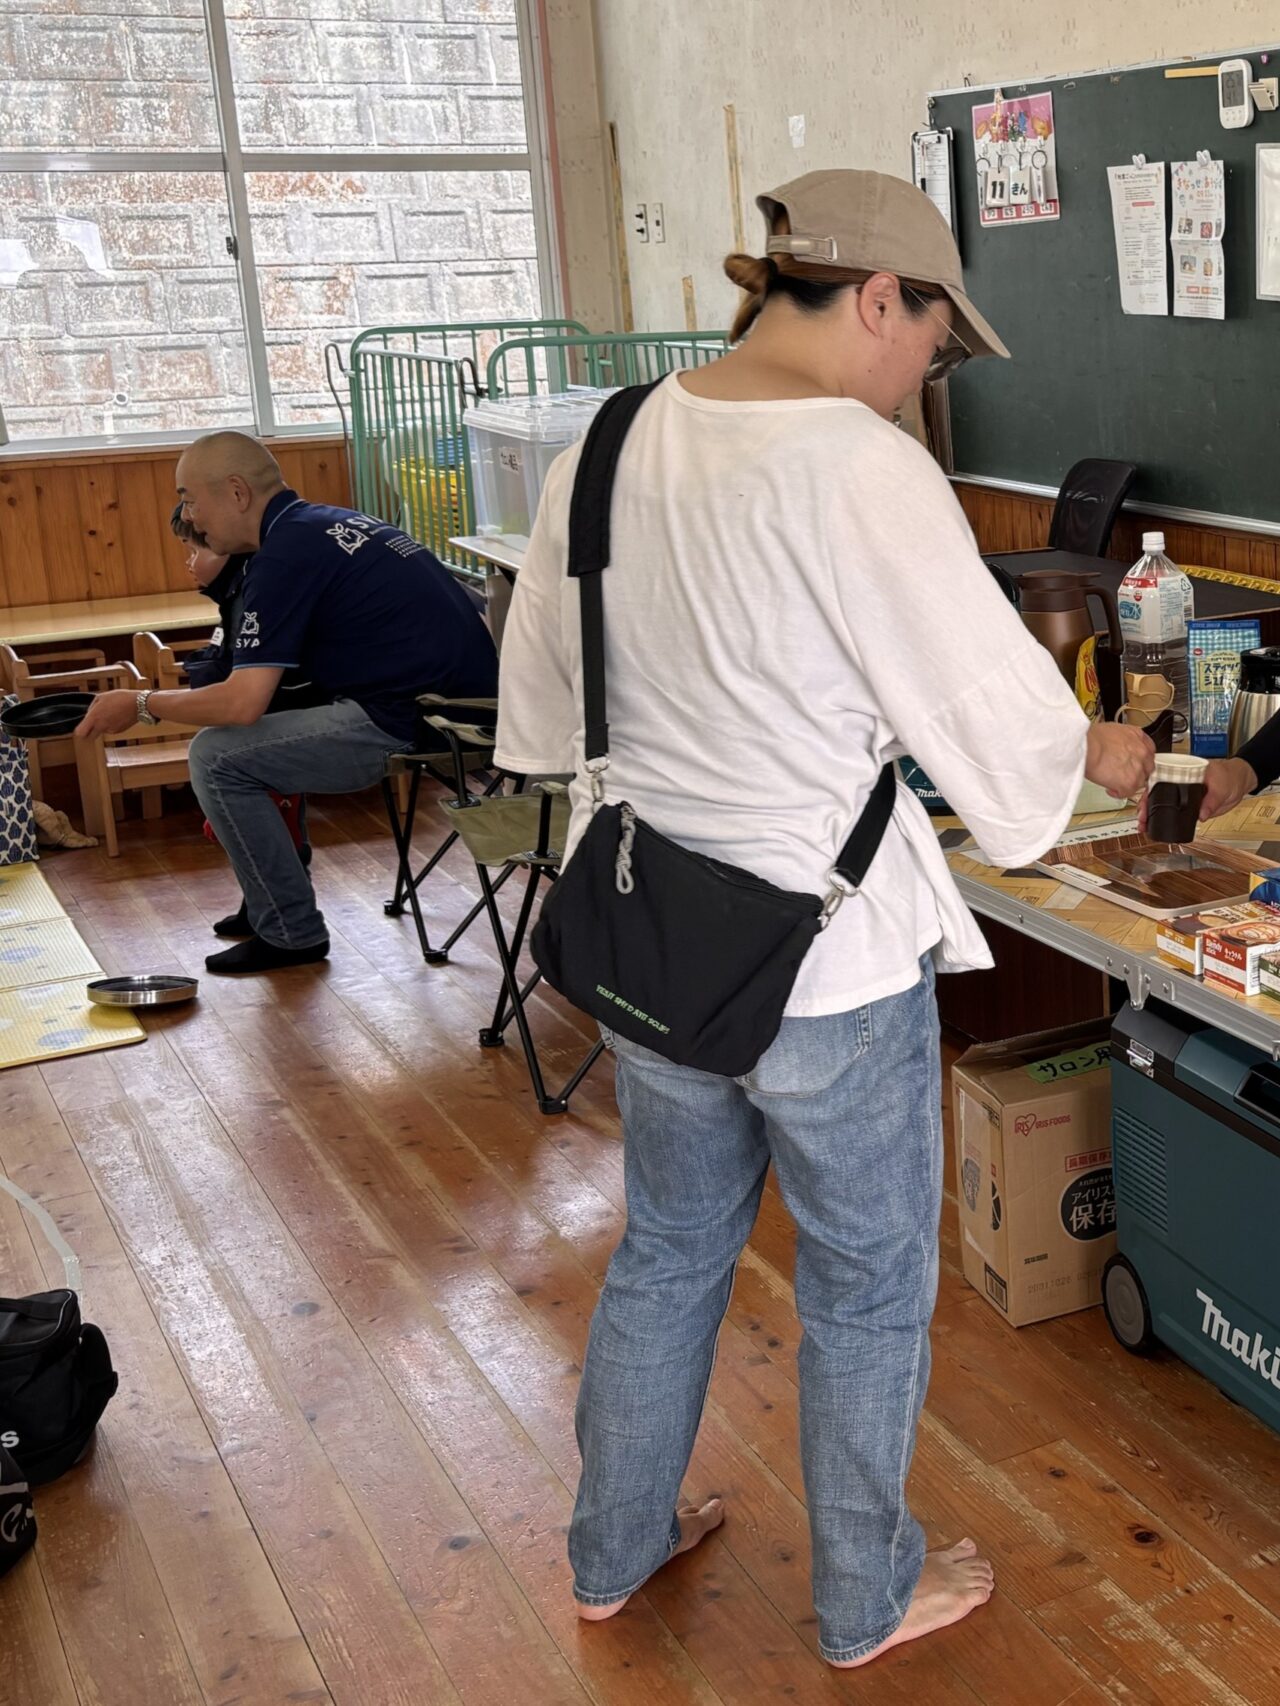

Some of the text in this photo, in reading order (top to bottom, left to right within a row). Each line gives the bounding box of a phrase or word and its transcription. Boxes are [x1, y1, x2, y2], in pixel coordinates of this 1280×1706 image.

[991, 180, 1005, 199] 11
[1011, 182, 1028, 196] きん
[1068, 1151, 1112, 1169] 長期保存
[1071, 1183, 1114, 1204] アイリス
[1069, 1199, 1117, 1233] 保存
